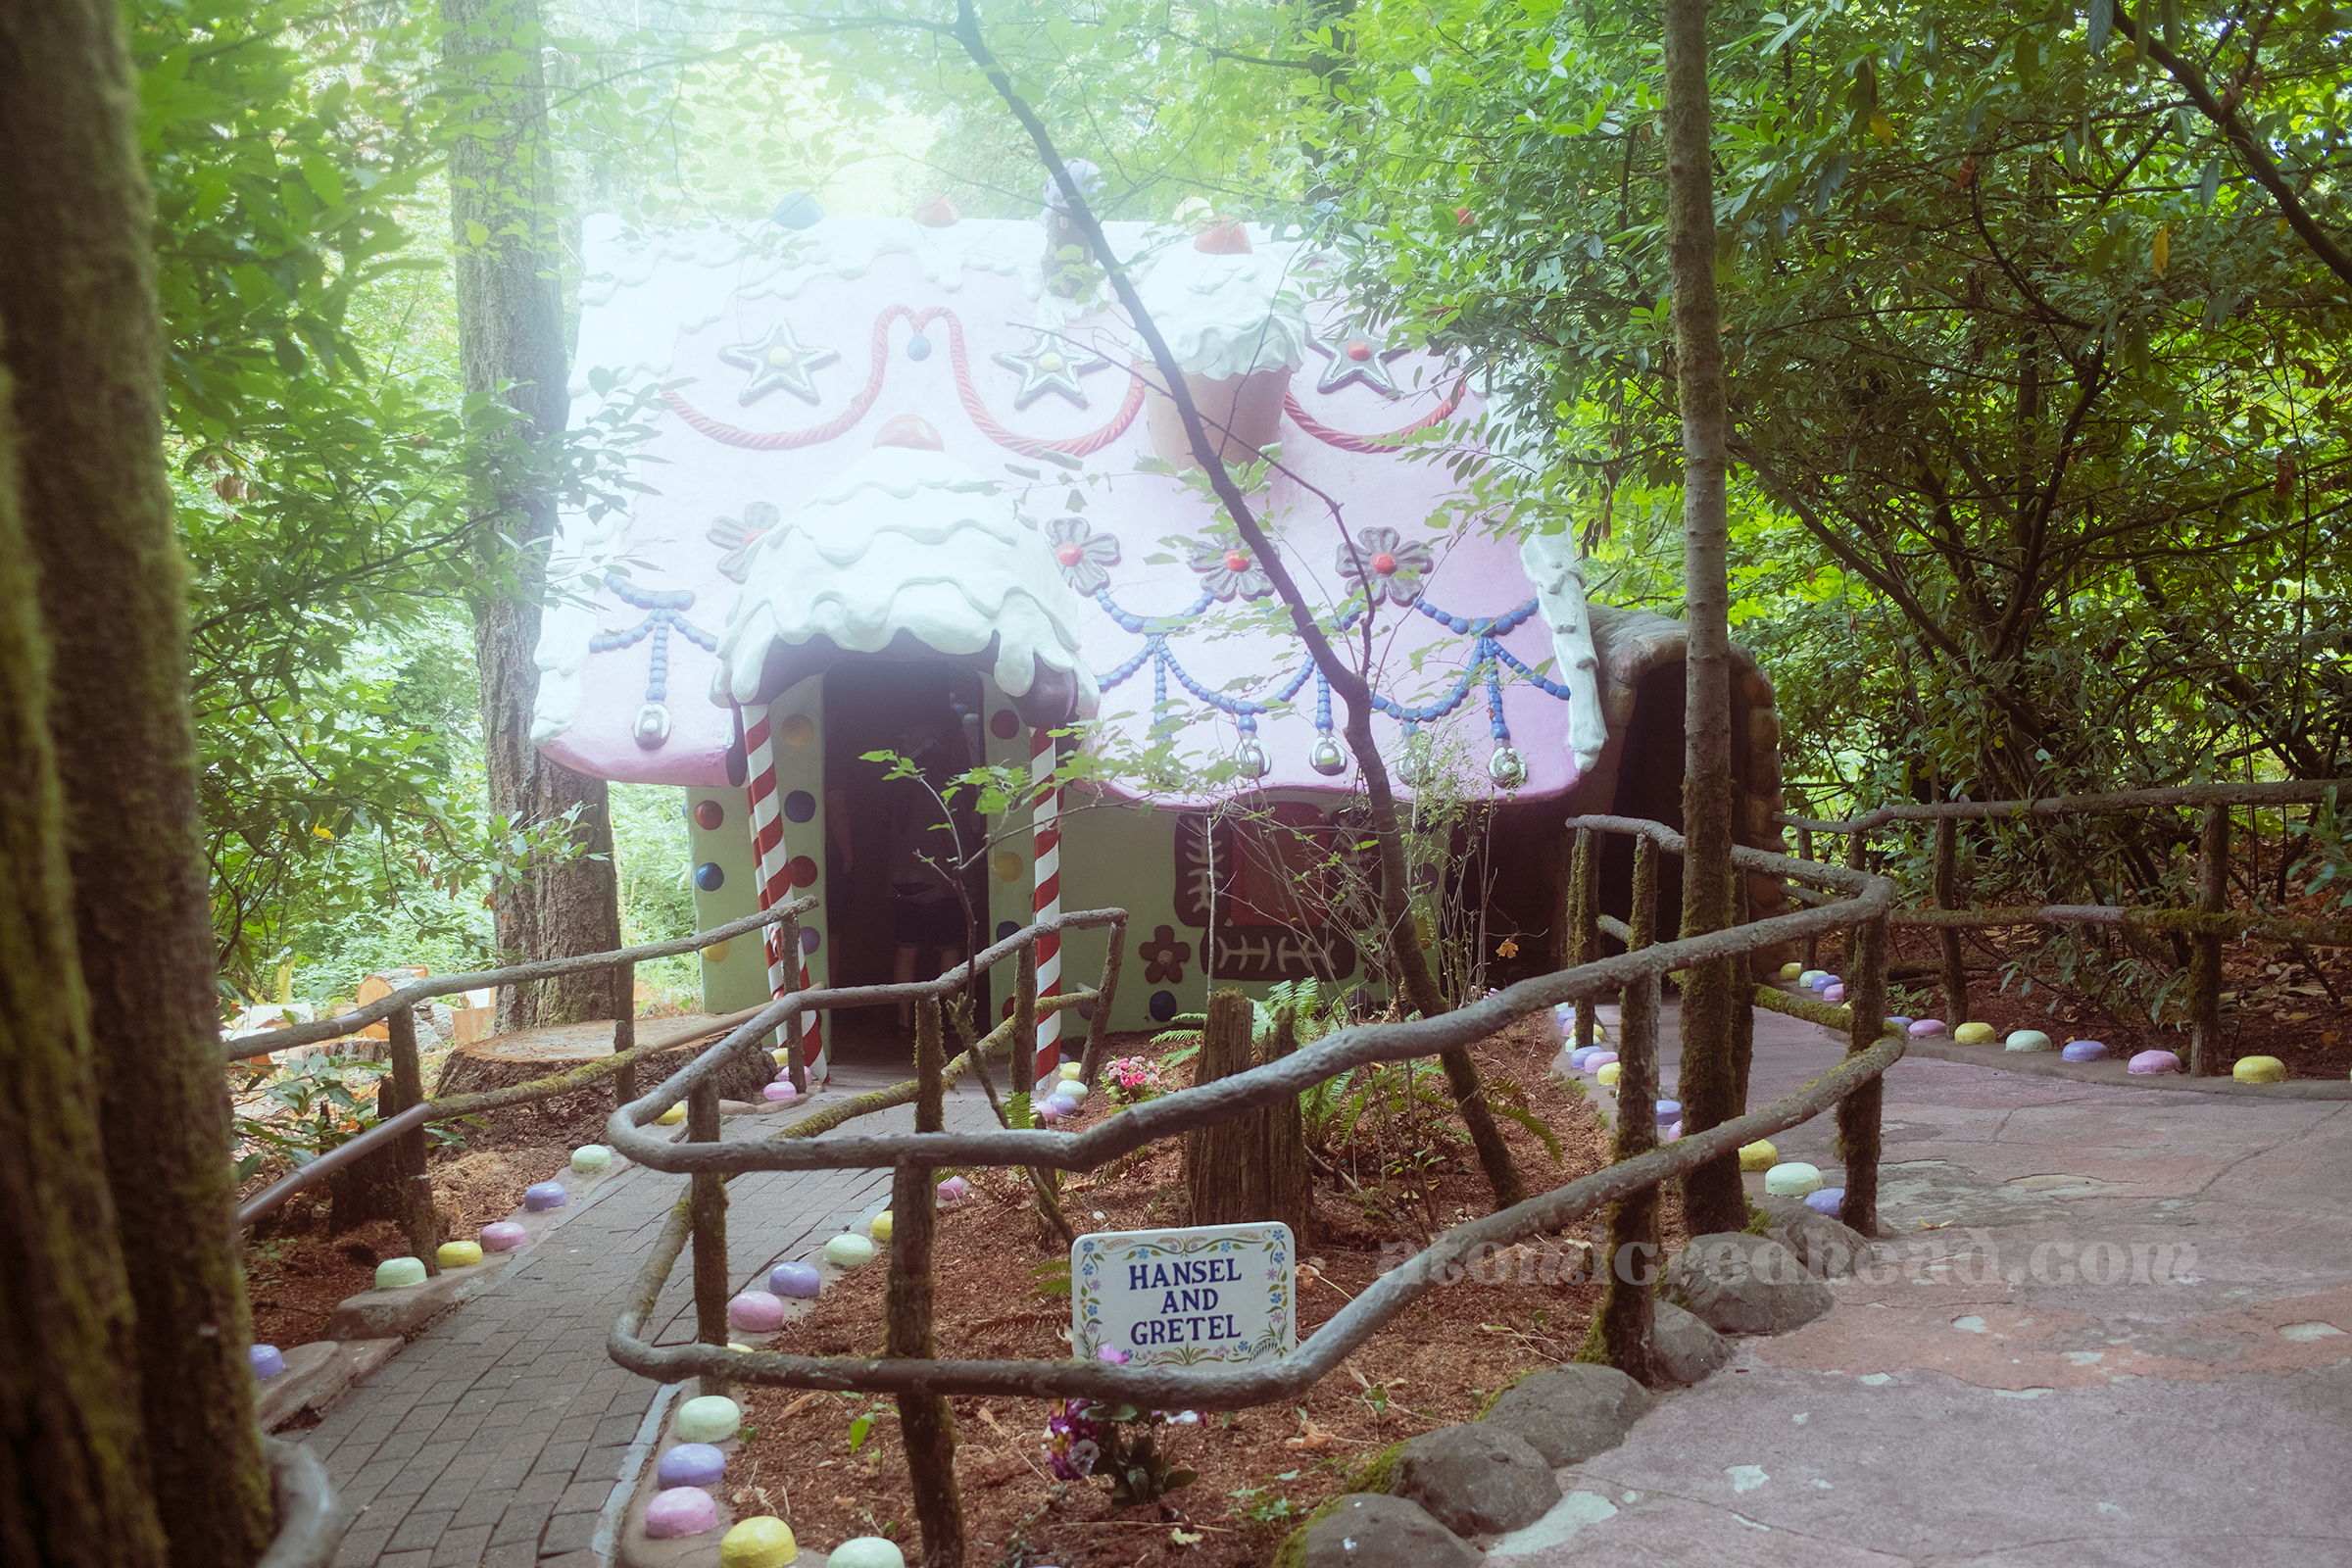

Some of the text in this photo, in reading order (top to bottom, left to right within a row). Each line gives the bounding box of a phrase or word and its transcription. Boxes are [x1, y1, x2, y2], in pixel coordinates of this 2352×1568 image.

[1129, 1258, 1242, 1290] HANSEL
[1161, 1288, 1219, 1314] AND
[1131, 1314, 1242, 1346] GRETEL
